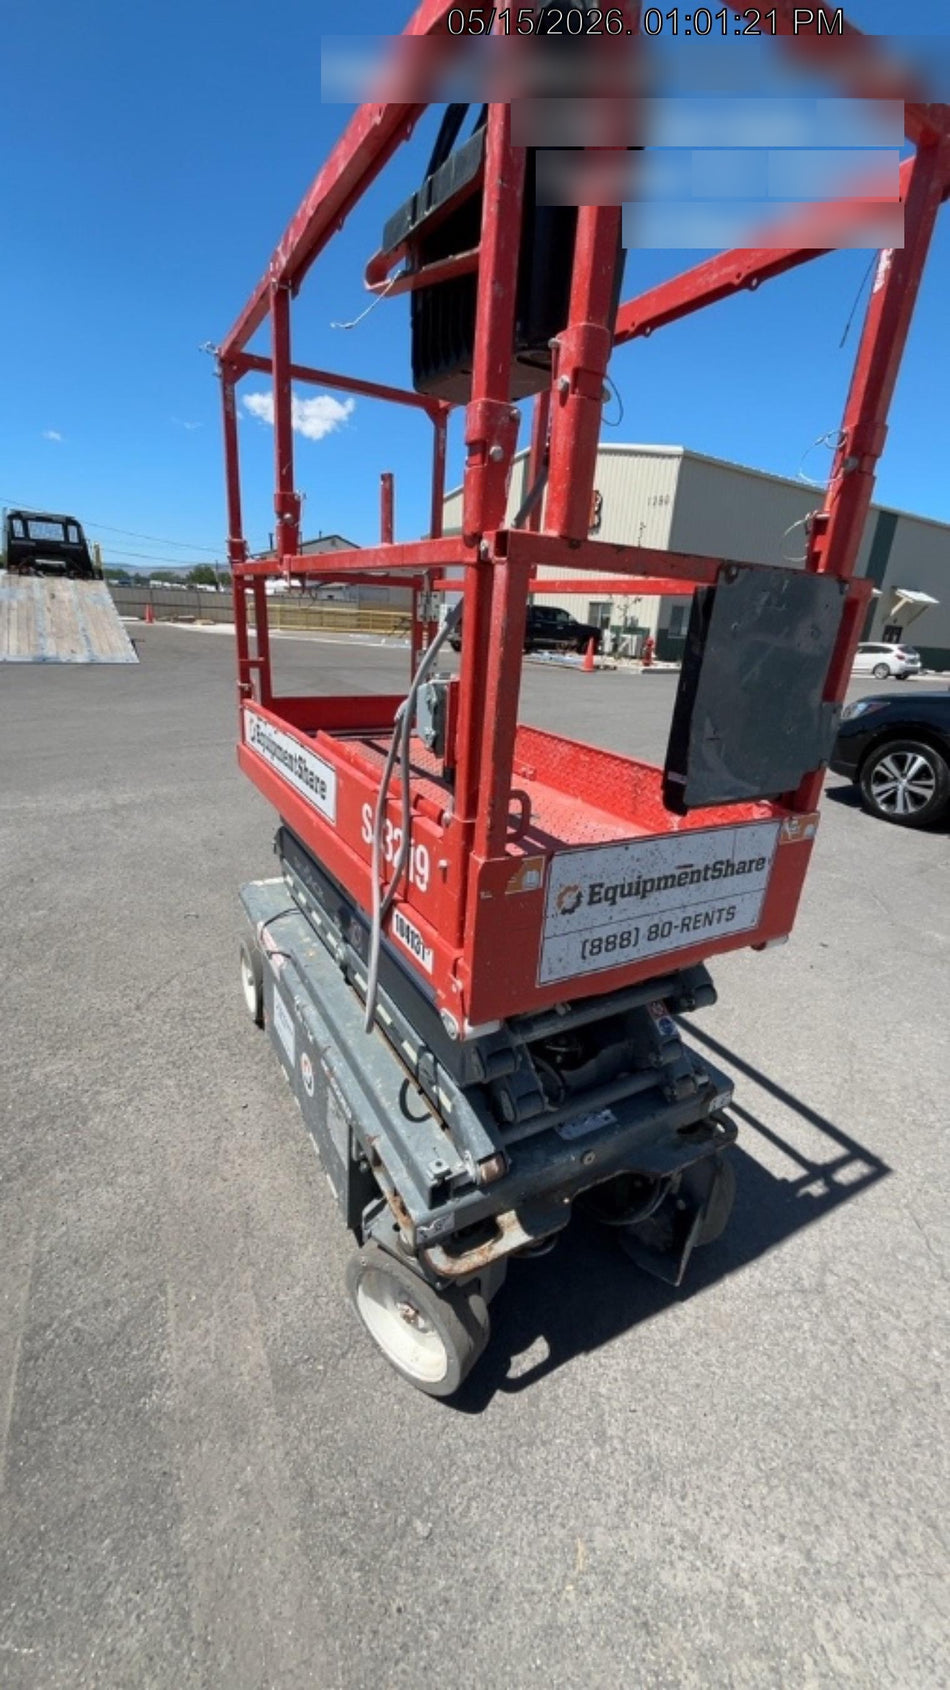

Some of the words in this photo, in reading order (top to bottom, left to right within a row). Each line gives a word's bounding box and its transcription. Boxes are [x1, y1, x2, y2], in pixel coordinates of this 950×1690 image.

[255, 723, 327, 801] EquipmentShare
[361, 802, 430, 893] S3219
[587, 856, 766, 906] EquipmentShare
[581, 928, 639, 960] (888)
[647, 906, 736, 942] 80-RENTS
